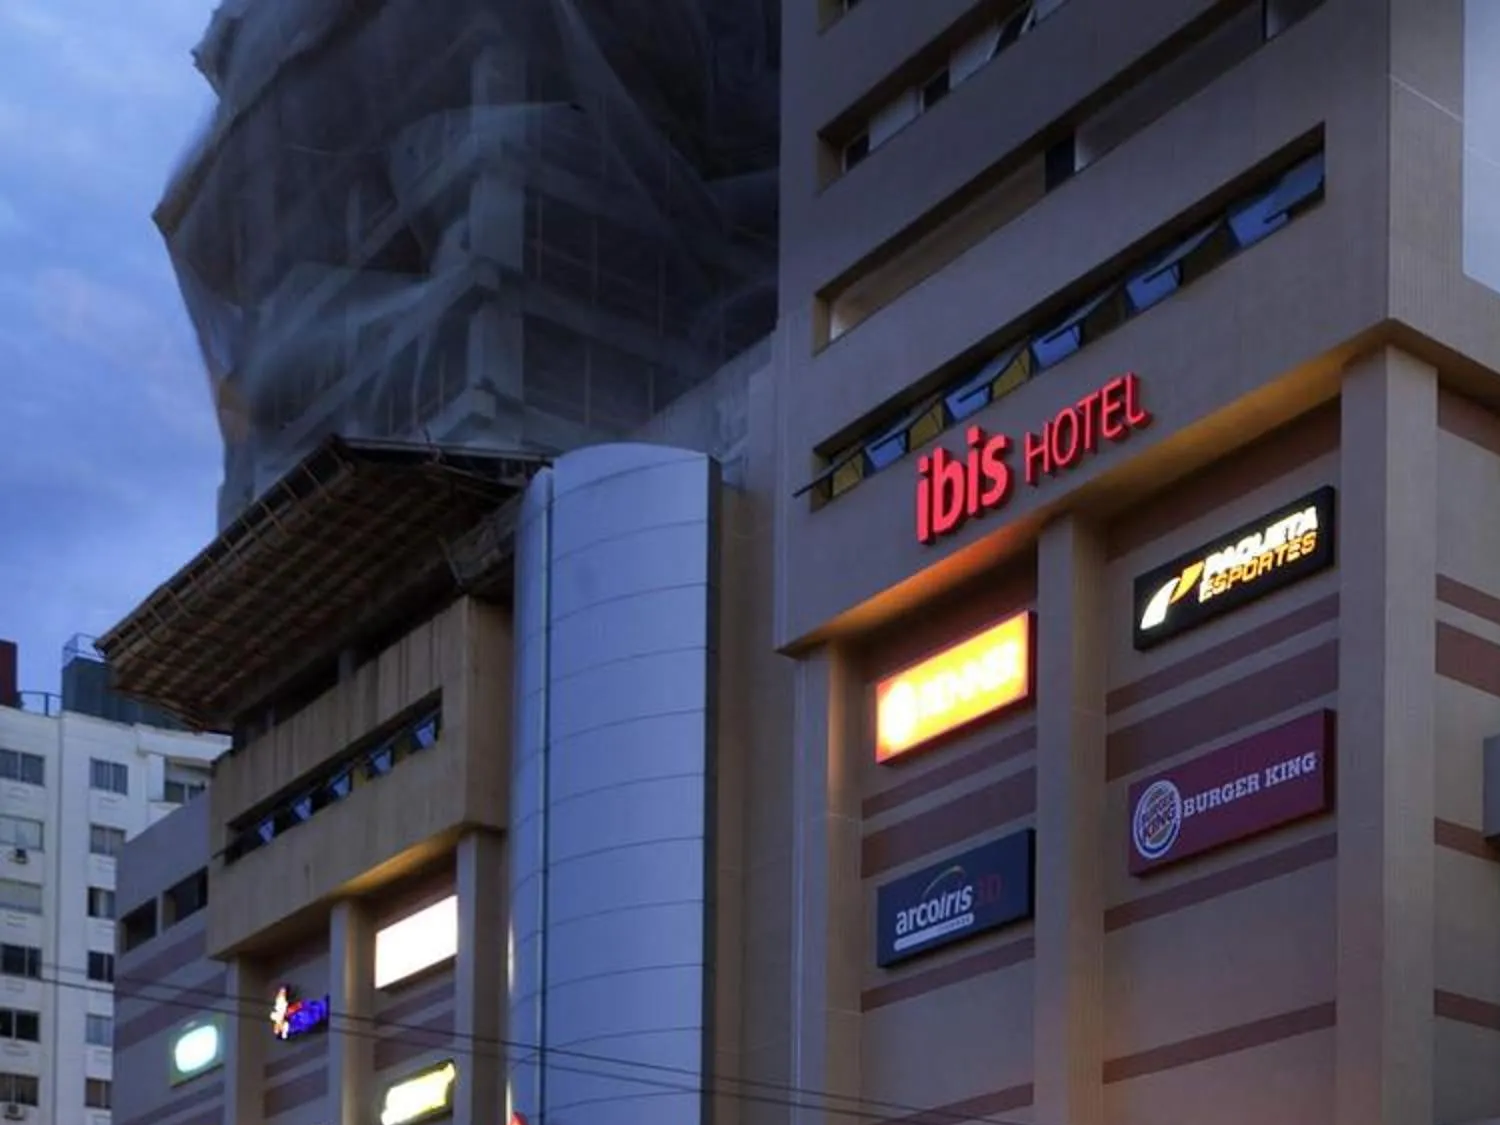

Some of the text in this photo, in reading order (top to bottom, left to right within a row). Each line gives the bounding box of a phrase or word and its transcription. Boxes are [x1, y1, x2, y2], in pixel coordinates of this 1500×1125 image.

[916, 373, 1147, 543] ibis HOTEL
[1199, 531, 1317, 603] ESPORTES
[1183, 774, 1260, 818] BURGER
[1264, 752, 1317, 788] KING
